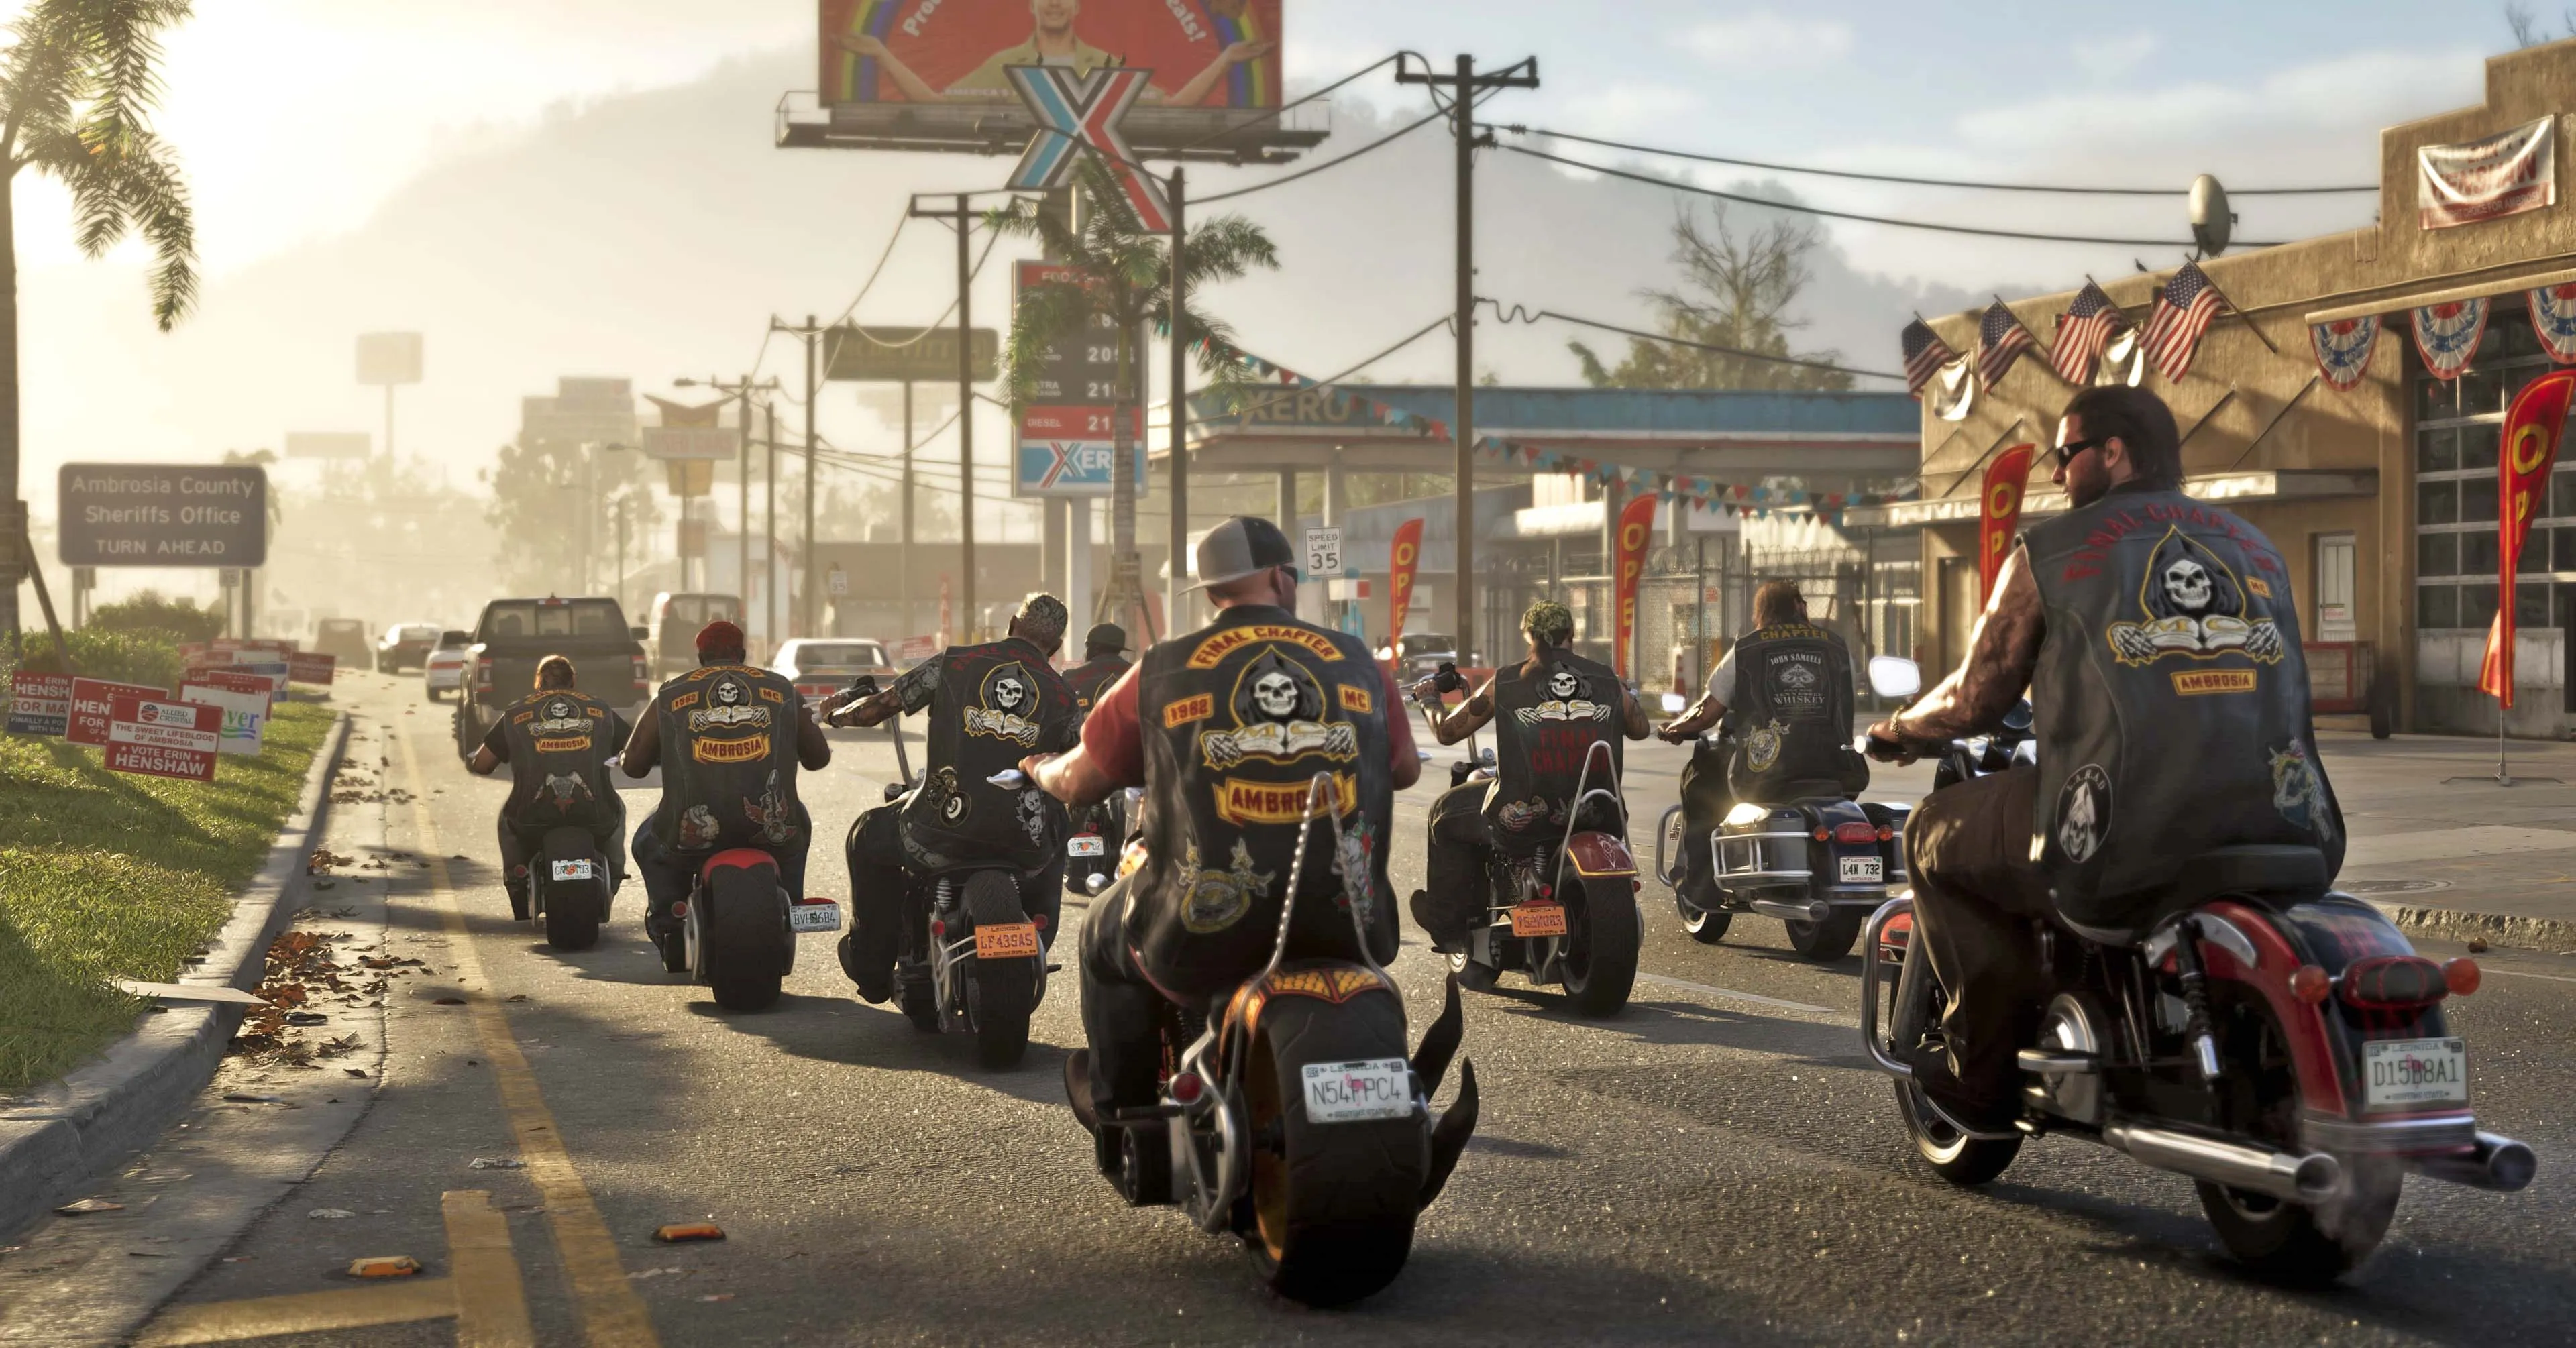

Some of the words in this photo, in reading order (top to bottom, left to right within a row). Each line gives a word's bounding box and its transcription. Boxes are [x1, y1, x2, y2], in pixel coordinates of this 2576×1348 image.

[1238, 389, 1351, 433] XERO
[1027, 418, 1063, 428] DIESEL
[71, 475, 171, 494] Ambrosia
[180, 476, 255, 498] County
[85, 505, 170, 524] Sheriffs
[180, 506, 241, 524] Office
[1309, 533, 1338, 542] SPEED
[95, 539, 146, 554] TURN
[157, 539, 225, 555] AHEAD
[1311, 553, 1338, 569] 35
[1760, 629, 1829, 640] CHAPTER
[1195, 630, 1248, 665] FINAL
[1253, 627, 1335, 657] CHAPTER
[1770, 654, 1788, 665] JOHN
[1790, 653, 1821, 665] SAMUELS
[45, 677, 68, 686] ERIN
[2182, 674, 2250, 689] AMBROSIA
[107, 693, 114, 701] E
[763, 689, 780, 700] MC
[1344, 690, 1366, 708] MC
[1774, 696, 1825, 705] WHISKEY
[74, 699, 111, 716] HEN
[160, 708, 189, 717] ALLIED
[79, 716, 105, 728] FOR
[160, 716, 193, 725] CRYSTAL
[223, 710, 260, 728] ver
[115, 724, 132, 732] THE
[135, 725, 164, 735] SWEET
[167, 729, 215, 742] LIFEBLOOD
[148, 736, 193, 747] AMBROSIA
[541, 738, 585, 750] AMBROSIA
[701, 738, 762, 757] AMBROSIA
[131, 745, 162, 757] VOTE
[164, 750, 191, 761] ERIN
[115, 753, 206, 776] HENSHAW
[1864, 864, 1880, 875] 732
[2373, 1056, 2460, 1086] D15B8A1
[1312, 1076, 1401, 1105] N54FPC4
